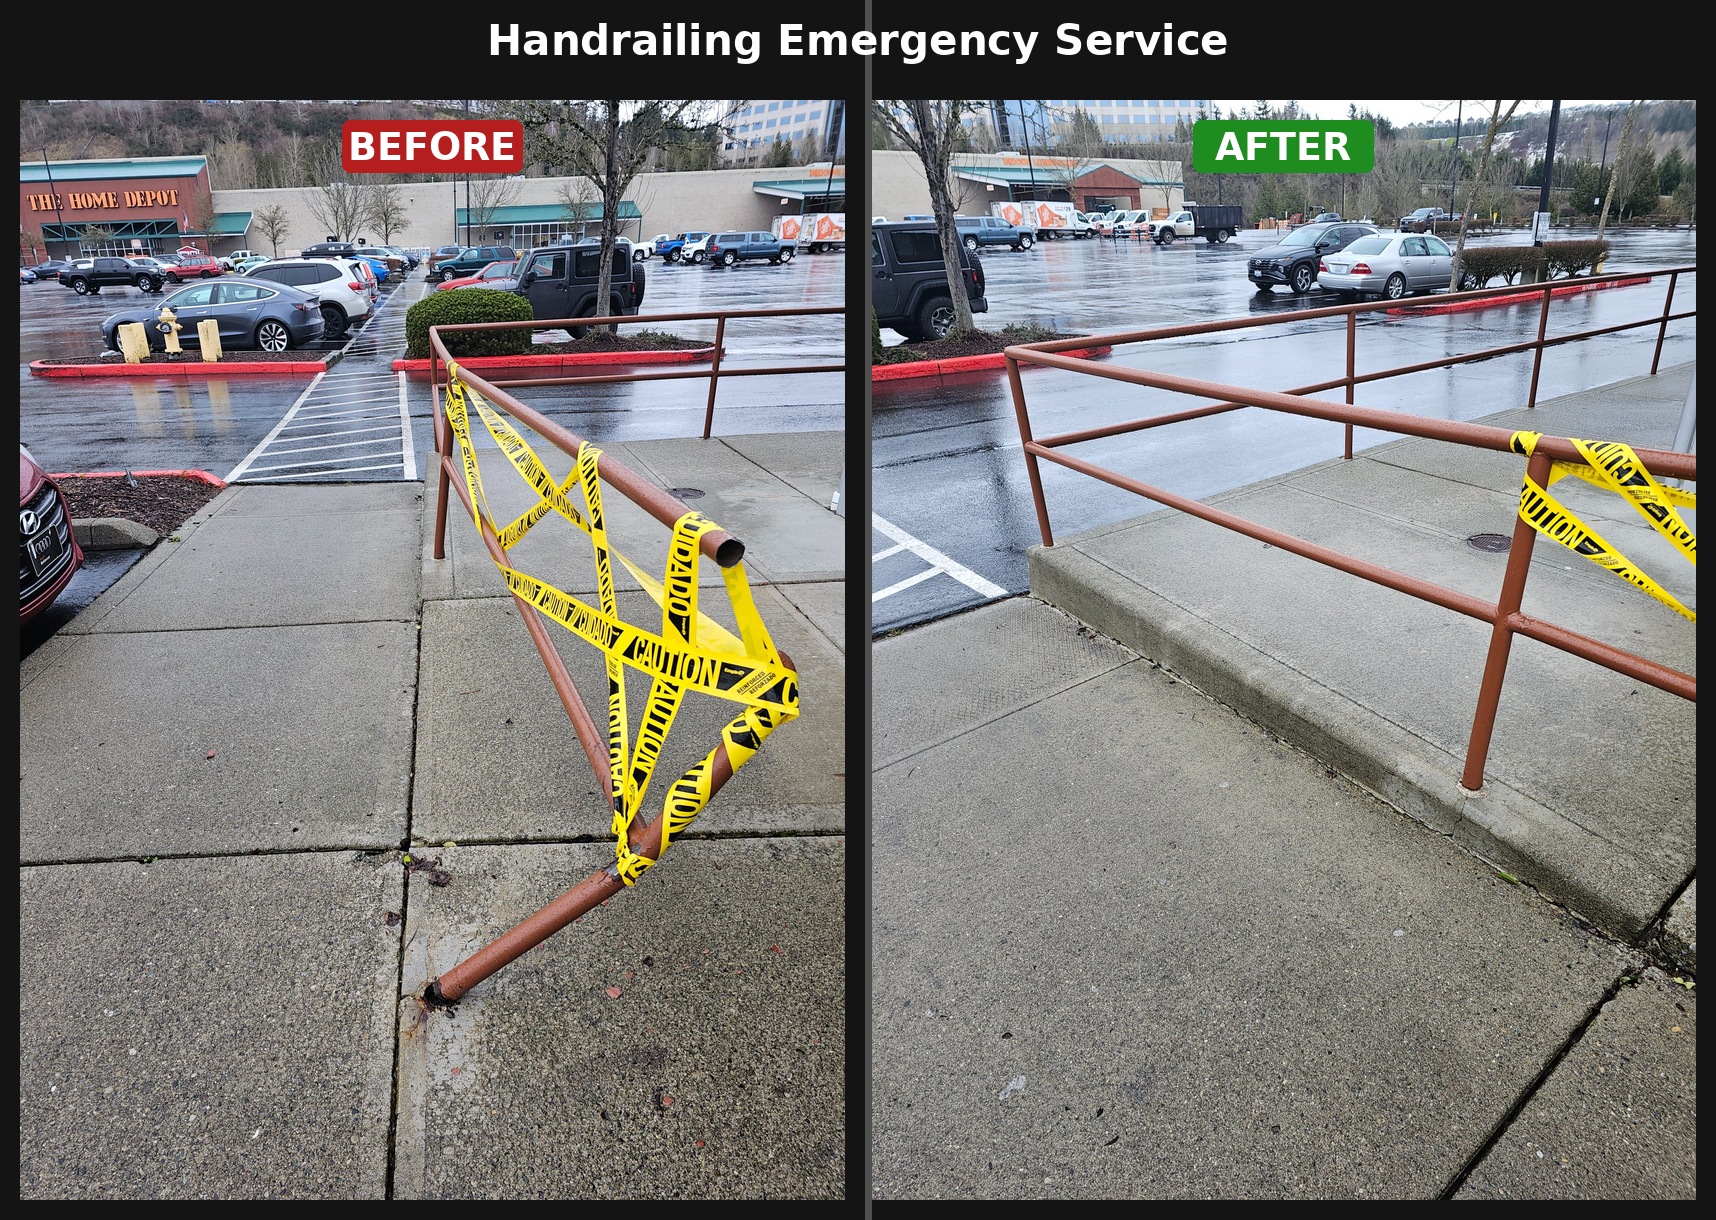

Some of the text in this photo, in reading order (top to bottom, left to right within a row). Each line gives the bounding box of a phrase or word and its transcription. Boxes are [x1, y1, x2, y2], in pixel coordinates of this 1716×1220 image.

[27, 189, 179, 211] THE HOME DEPOT
[1590, 441, 1637, 484] CUID
[1521, 489, 1584, 550] AUTION
[543, 590, 570, 620] CAUTION
[578, 610, 614, 648] CUIDADO
[633, 637, 718, 688] CAUTION
[639, 681, 679, 773] AUTION
